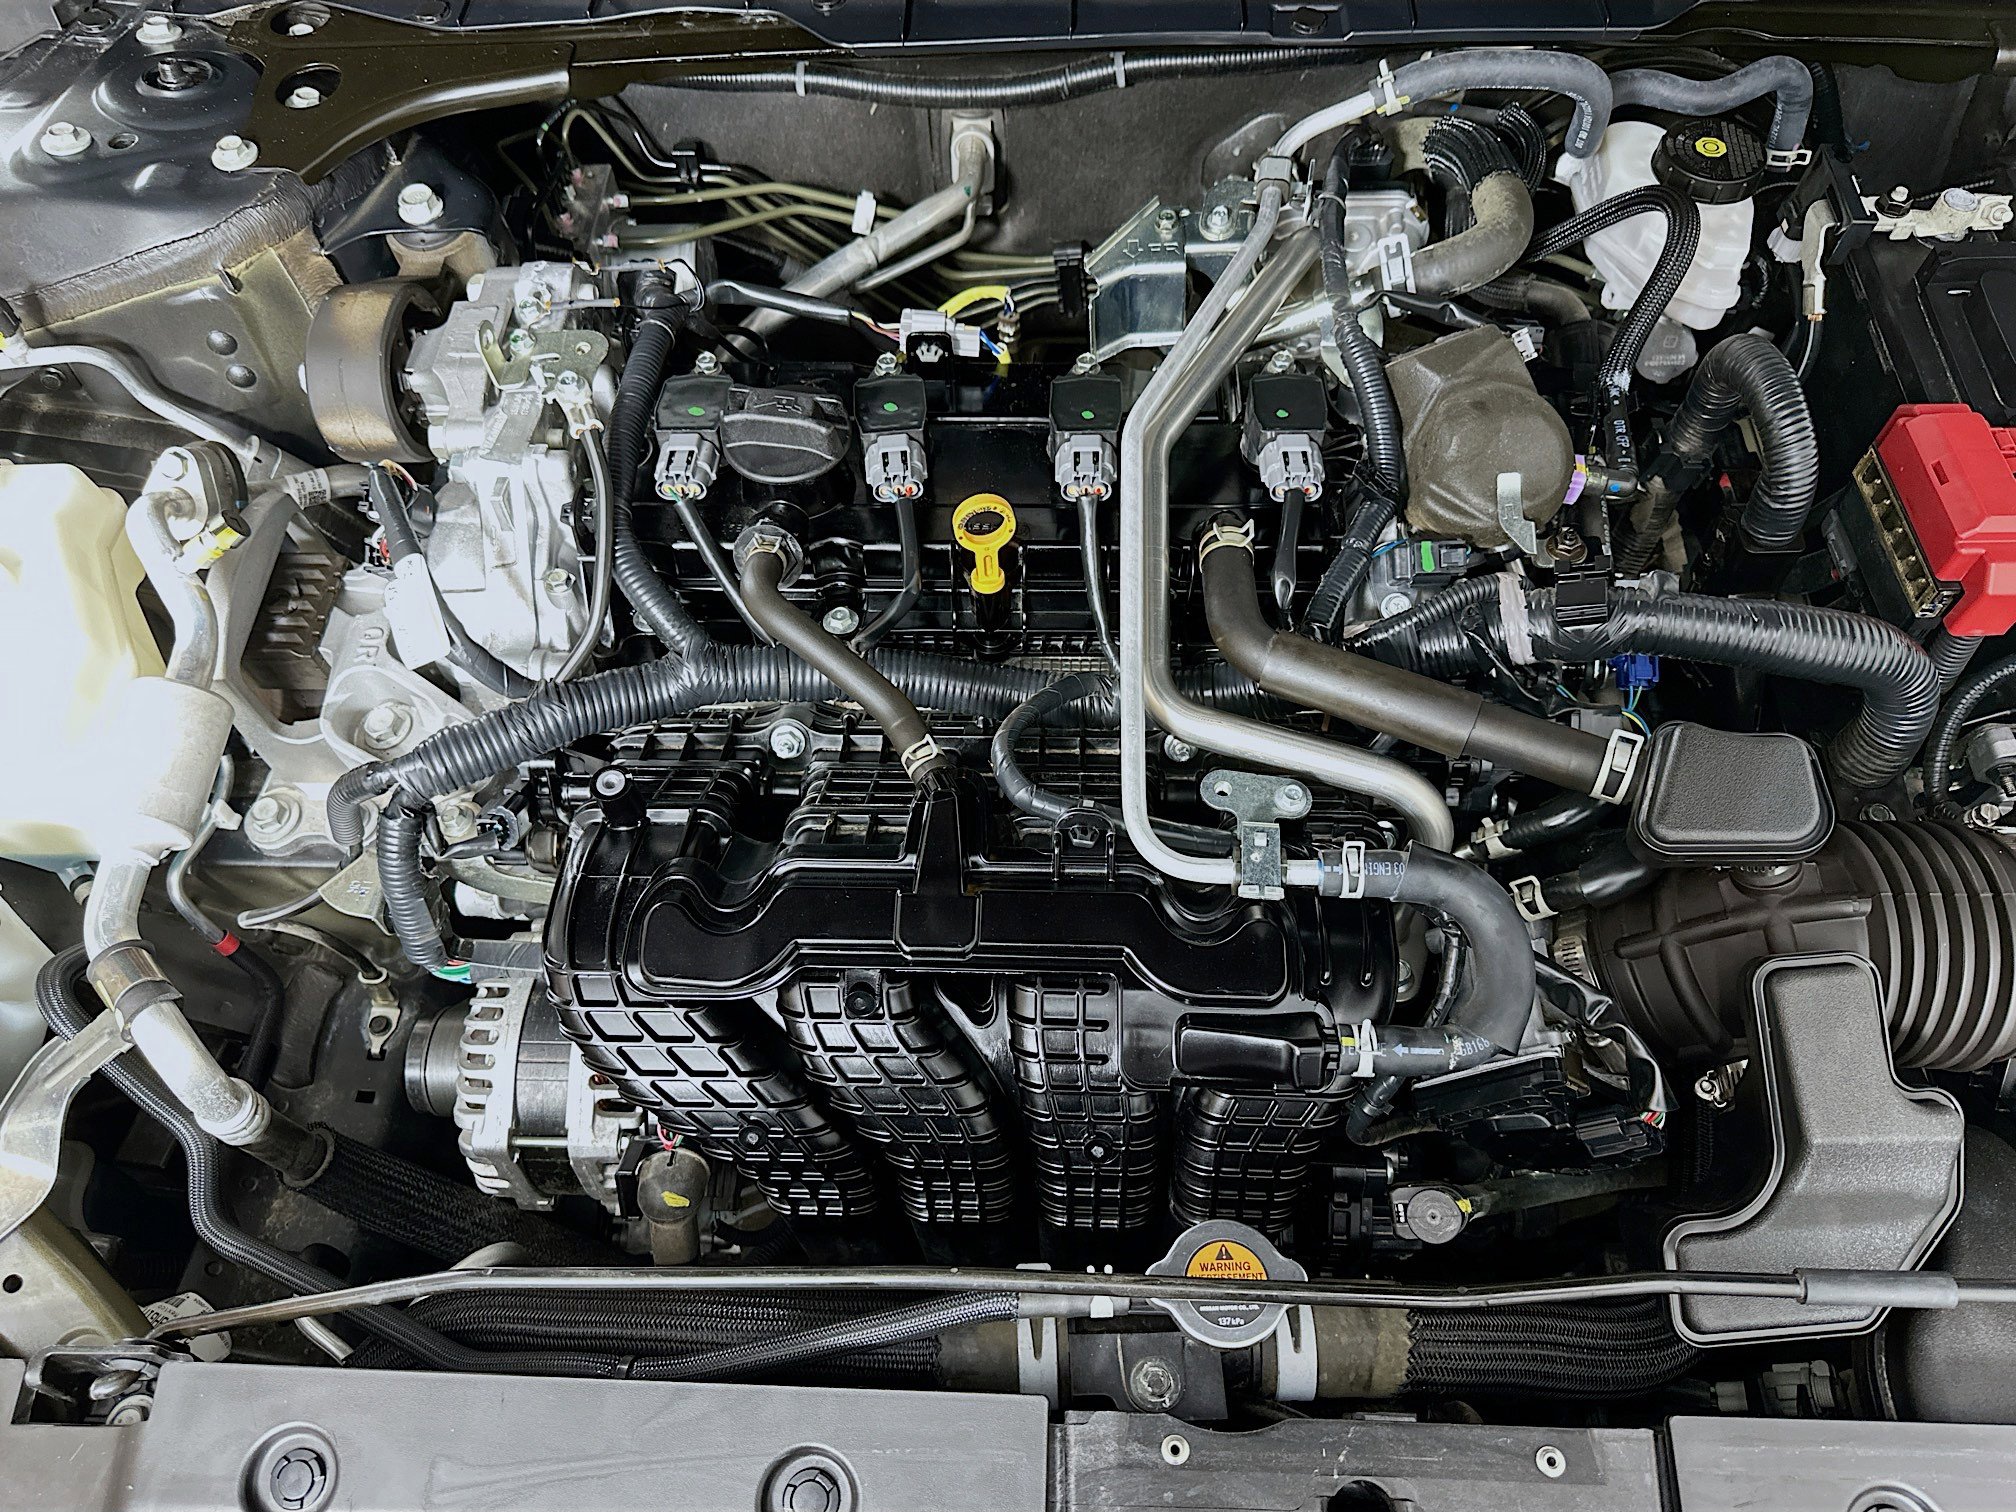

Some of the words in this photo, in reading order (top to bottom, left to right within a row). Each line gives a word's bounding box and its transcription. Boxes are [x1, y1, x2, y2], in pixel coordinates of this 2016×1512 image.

[1147, 242, 1180, 256] FR
[1364, 861, 1392, 876] ENGIN
[1199, 1261, 1251, 1272] WARNING
